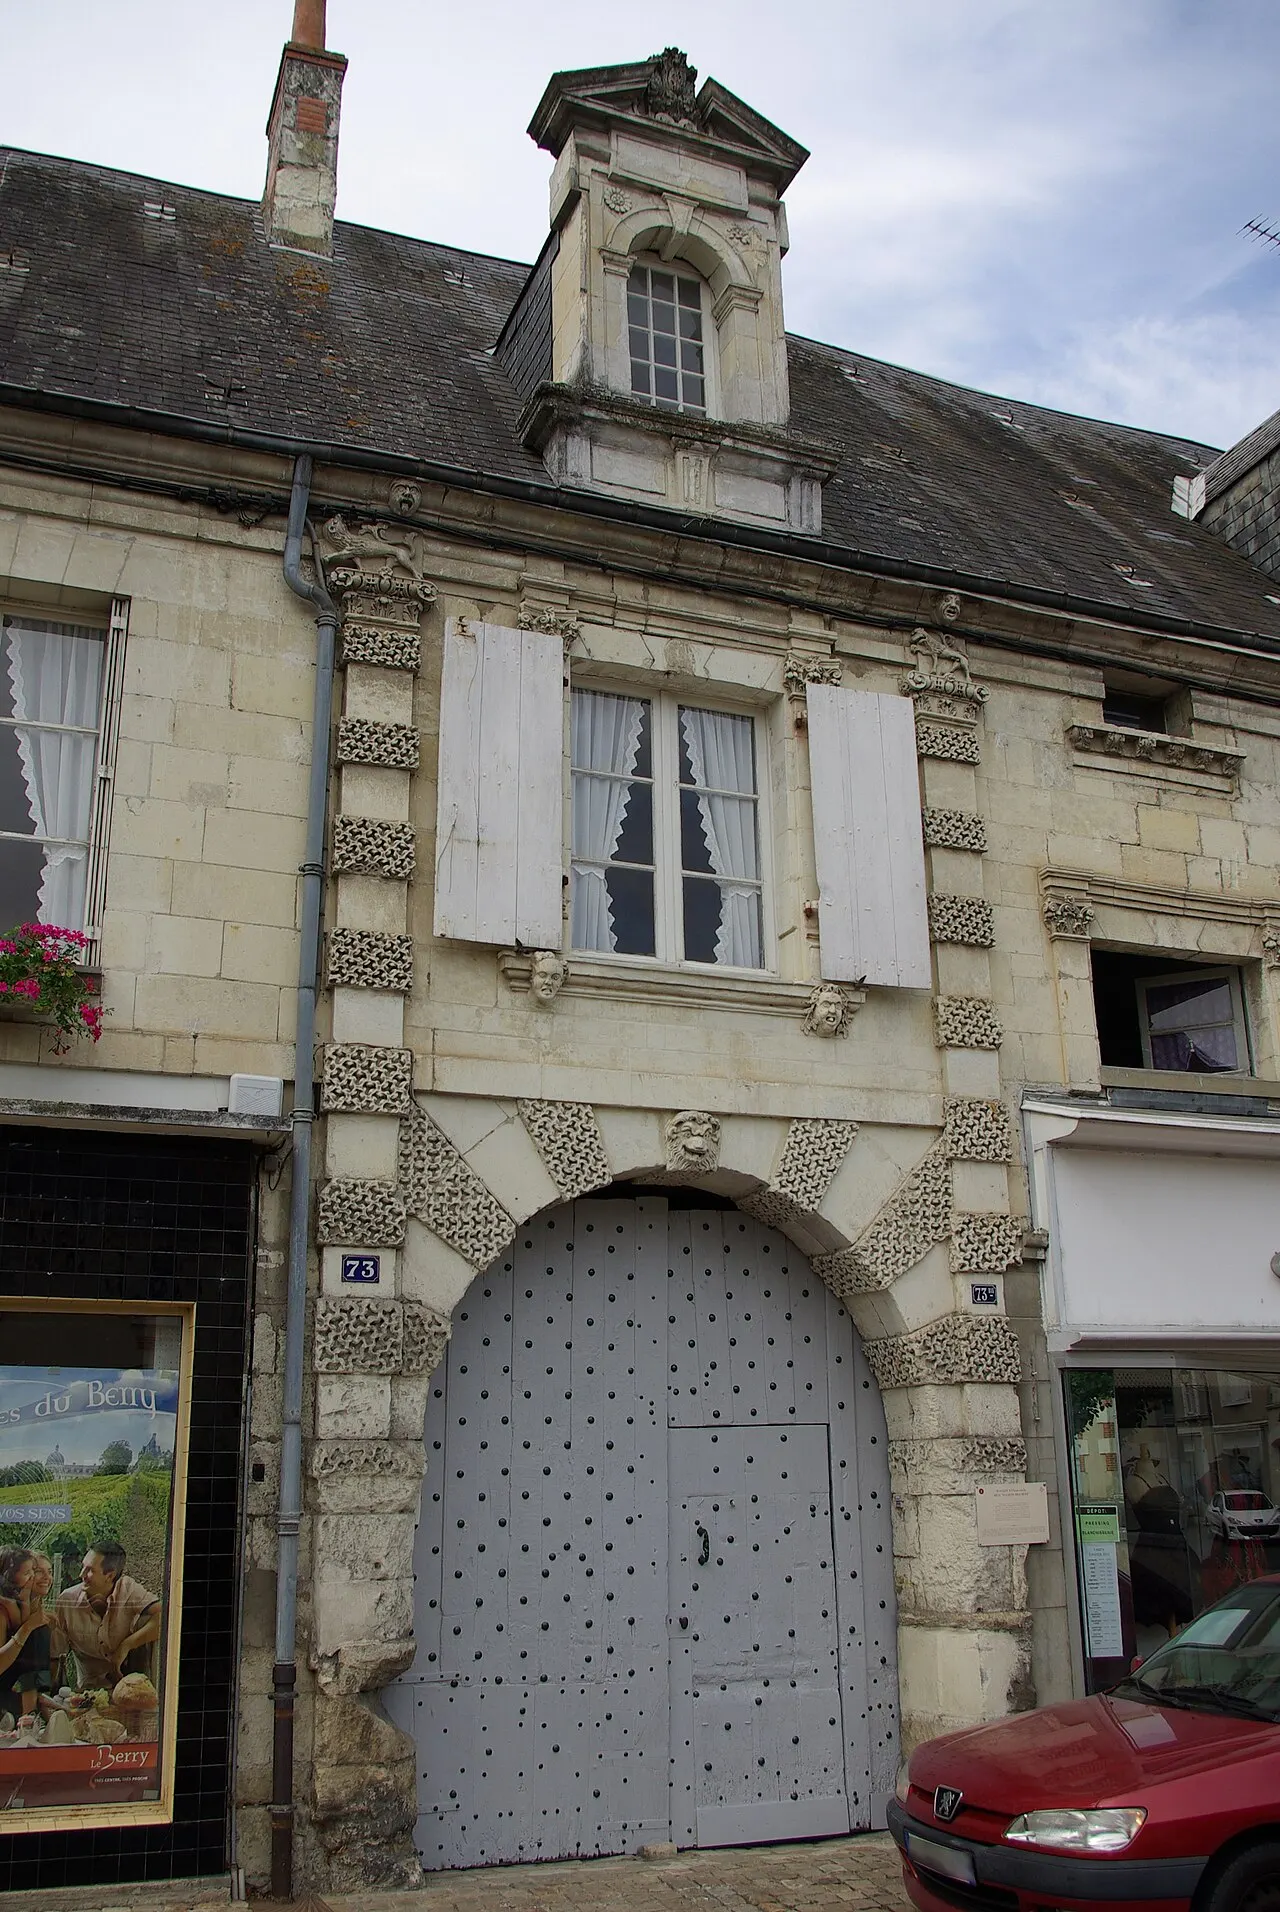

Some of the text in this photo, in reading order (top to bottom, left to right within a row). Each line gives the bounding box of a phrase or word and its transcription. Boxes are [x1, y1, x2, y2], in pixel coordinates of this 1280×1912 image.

[346, 1260, 375, 1278] 73
[975, 1287, 988, 1301] 73
[34, 1392, 73, 1417] du
[86, 1380, 157, 1420] Berry
[28, 1508, 66, 1519] SENS
[90, 1745, 149, 1770] Le Berry
